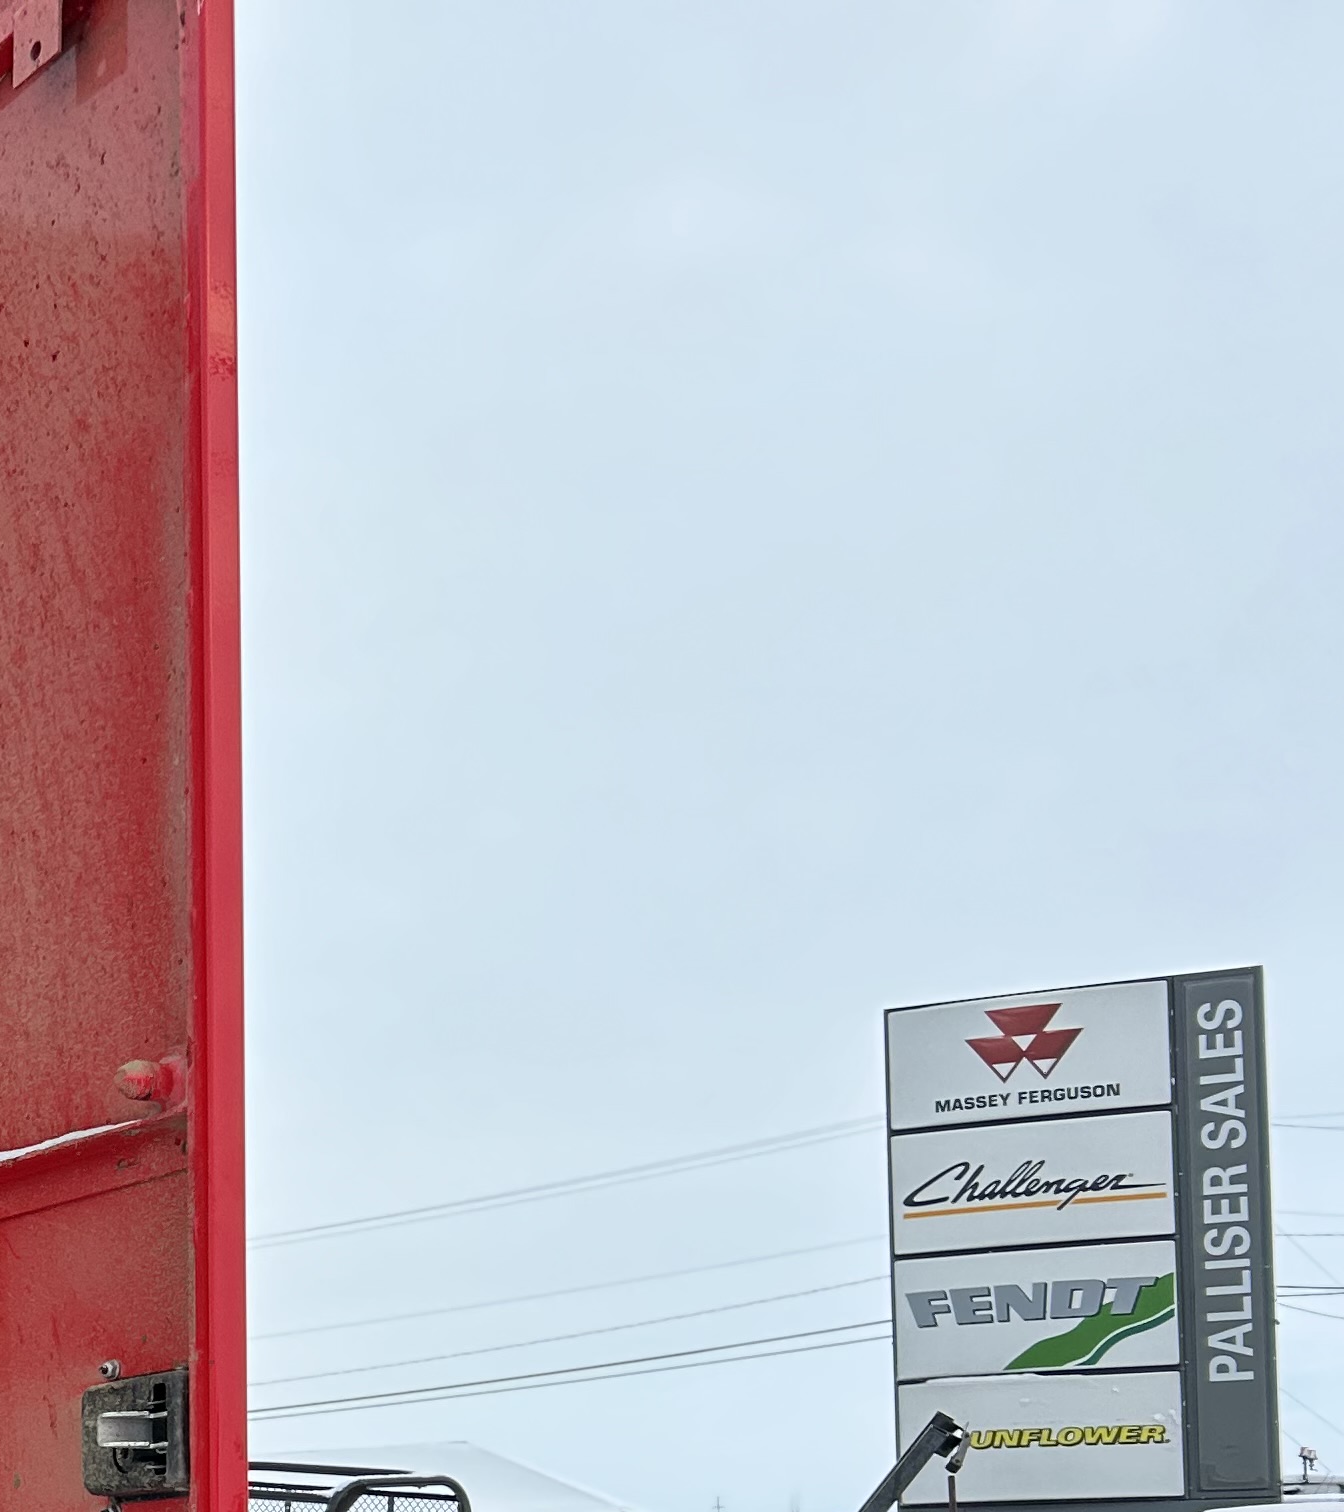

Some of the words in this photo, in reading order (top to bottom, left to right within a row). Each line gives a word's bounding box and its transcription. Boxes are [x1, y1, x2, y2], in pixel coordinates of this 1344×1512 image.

[935, 1092, 1010, 1114] MASSEY
[1017, 1083, 1121, 1106] FERGUSON
[1196, 999, 1248, 1149] SALES
[902, 1160, 1165, 1211] Challenger
[1202, 1163, 1255, 1382] PALLISER
[905, 1276, 1159, 1329] FENDT
[969, 1425, 1167, 1449] UNFLOWER
